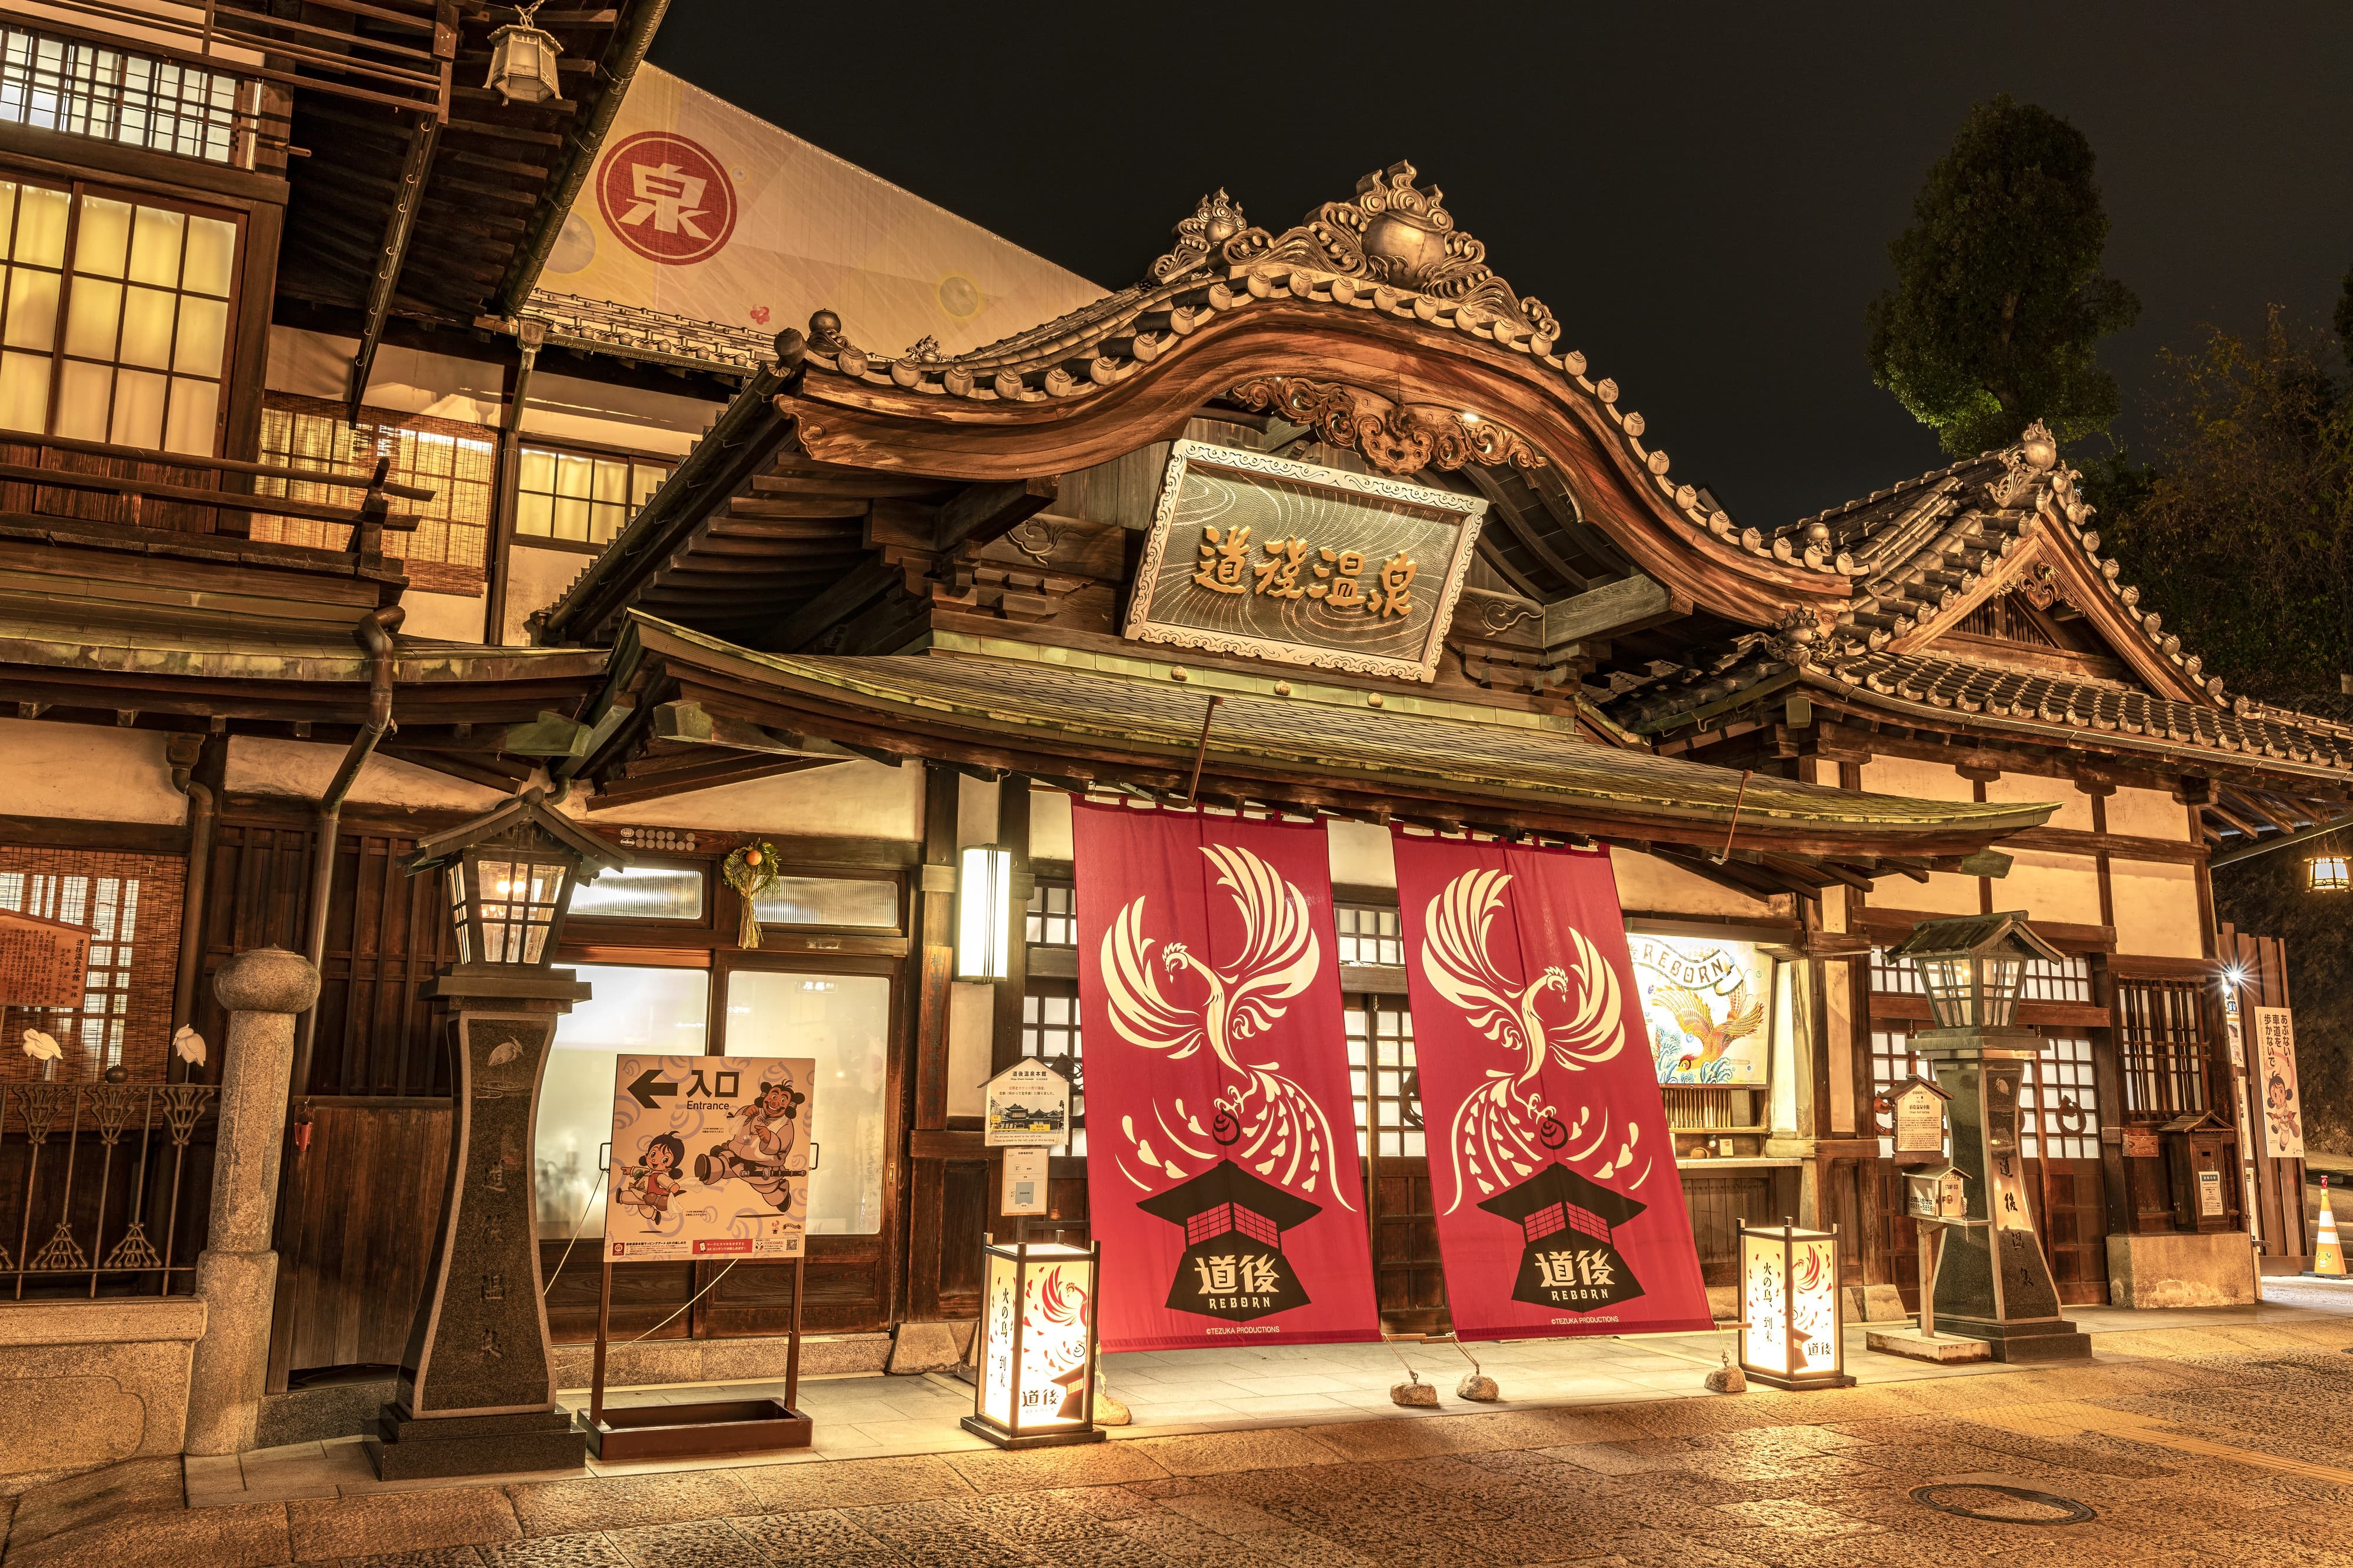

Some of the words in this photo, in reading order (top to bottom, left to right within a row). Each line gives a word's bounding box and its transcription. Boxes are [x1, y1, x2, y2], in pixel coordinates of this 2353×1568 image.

[618, 162, 714, 241] 泉
[1191, 525, 1418, 619] 道後温泉
[72, 939, 85, 982] 道後温泉本館
[1643, 943, 1724, 983] REBORN
[2264, 1014, 2275, 1067] 歩かないで
[2272, 1014, 2281, 1047] 車道を
[686, 1069, 740, 1098] 入口
[687, 1100, 729, 1110] Entrance
[1195, 1253, 1280, 1294] 道後
[1535, 1249, 1615, 1287] 道後
[1209, 1297, 1270, 1309] REBORN
[1551, 1289, 1608, 1301] REBORN
[1808, 1342, 1831, 1356] 道後
[1022, 1389, 1059, 1406] 道後
